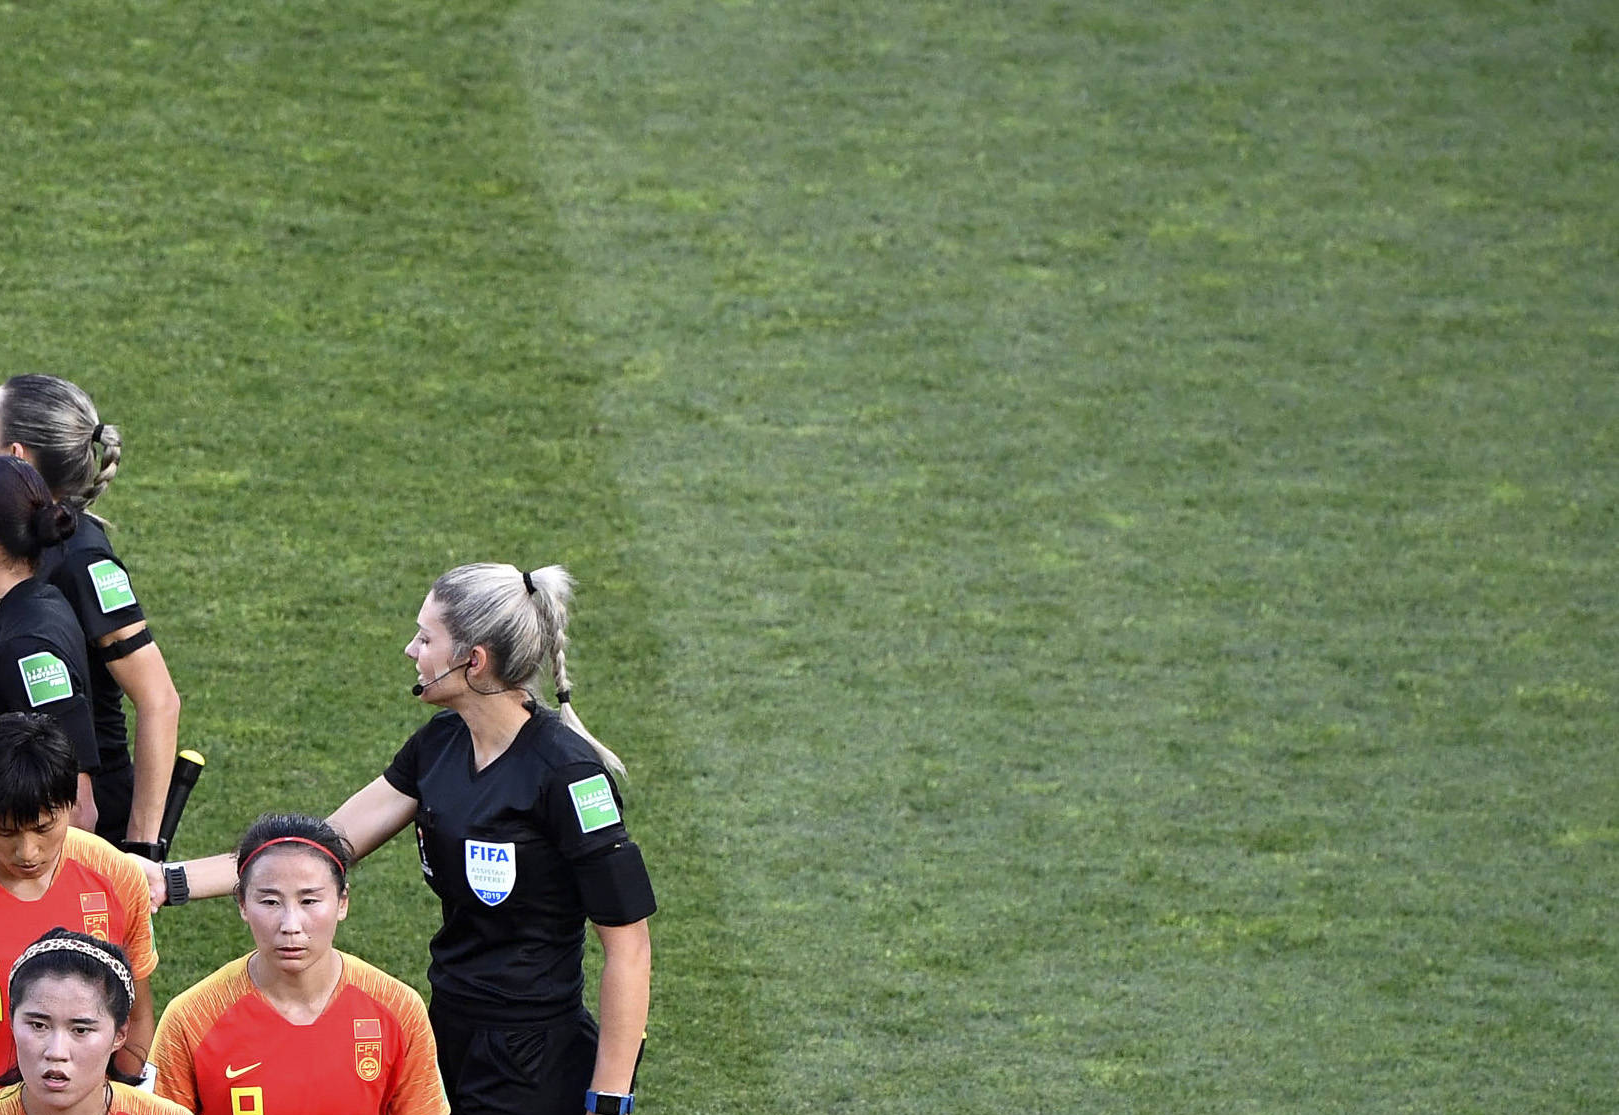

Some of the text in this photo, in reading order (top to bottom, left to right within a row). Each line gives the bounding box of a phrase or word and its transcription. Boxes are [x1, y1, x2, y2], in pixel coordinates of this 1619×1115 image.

[470, 844, 510, 863] FIFA
[482, 890, 502, 900] 2019
[84, 915, 107, 926] CFA
[357, 1044, 380, 1052] CFA
